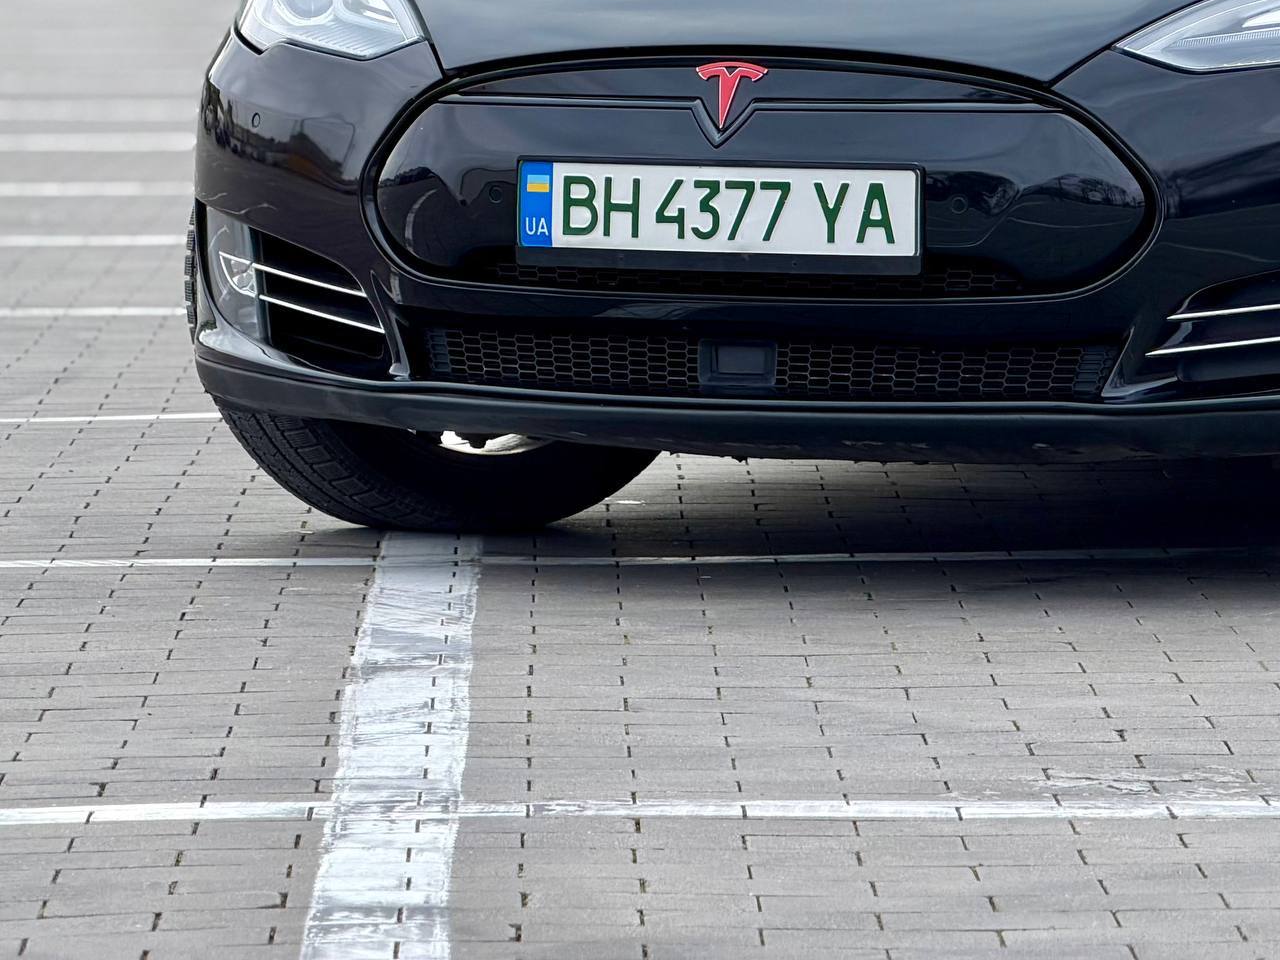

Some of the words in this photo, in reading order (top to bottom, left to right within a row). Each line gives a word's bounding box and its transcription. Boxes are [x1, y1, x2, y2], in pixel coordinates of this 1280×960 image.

[525, 216, 549, 236] UA
[561, 174, 641, 239] BH
[654, 178, 792, 242] 4377
[813, 181, 896, 244] YA
